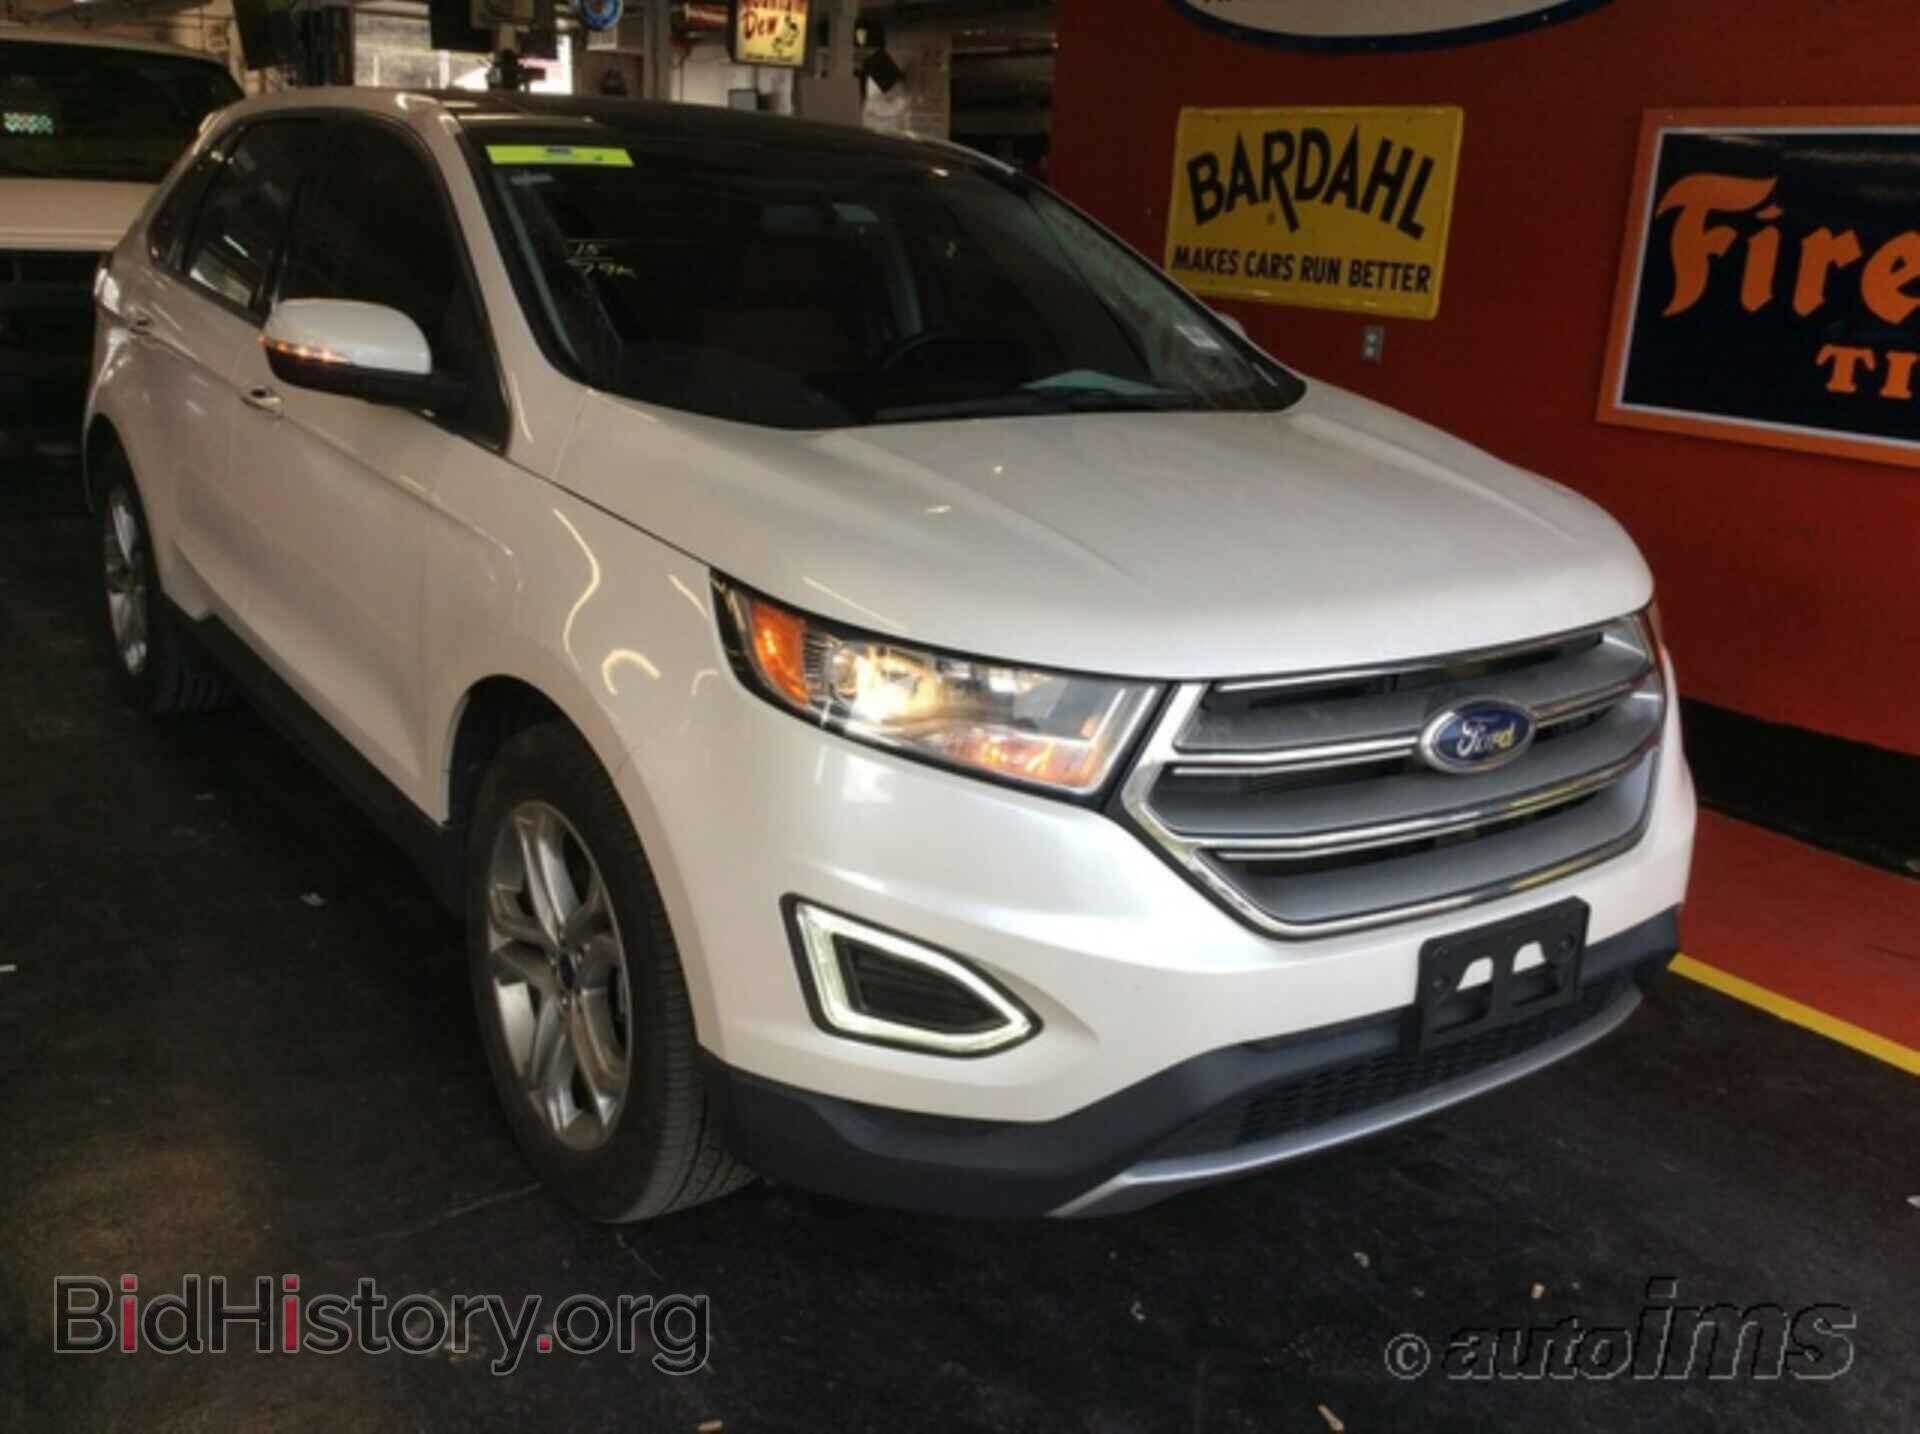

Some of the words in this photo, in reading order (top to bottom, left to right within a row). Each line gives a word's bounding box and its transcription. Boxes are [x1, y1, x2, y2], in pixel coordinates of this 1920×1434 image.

[743, 12, 778, 40] Dew
[1186, 123, 1435, 241] BARDAHL
[1172, 245, 1239, 276] MAKES
[1245, 249, 1296, 282] CARS
[1300, 256, 1341, 286] RUN
[1348, 259, 1431, 293] BETTER
[1815, 343, 1918, 398] TI
[1456, 720, 1516, 757] Ford
